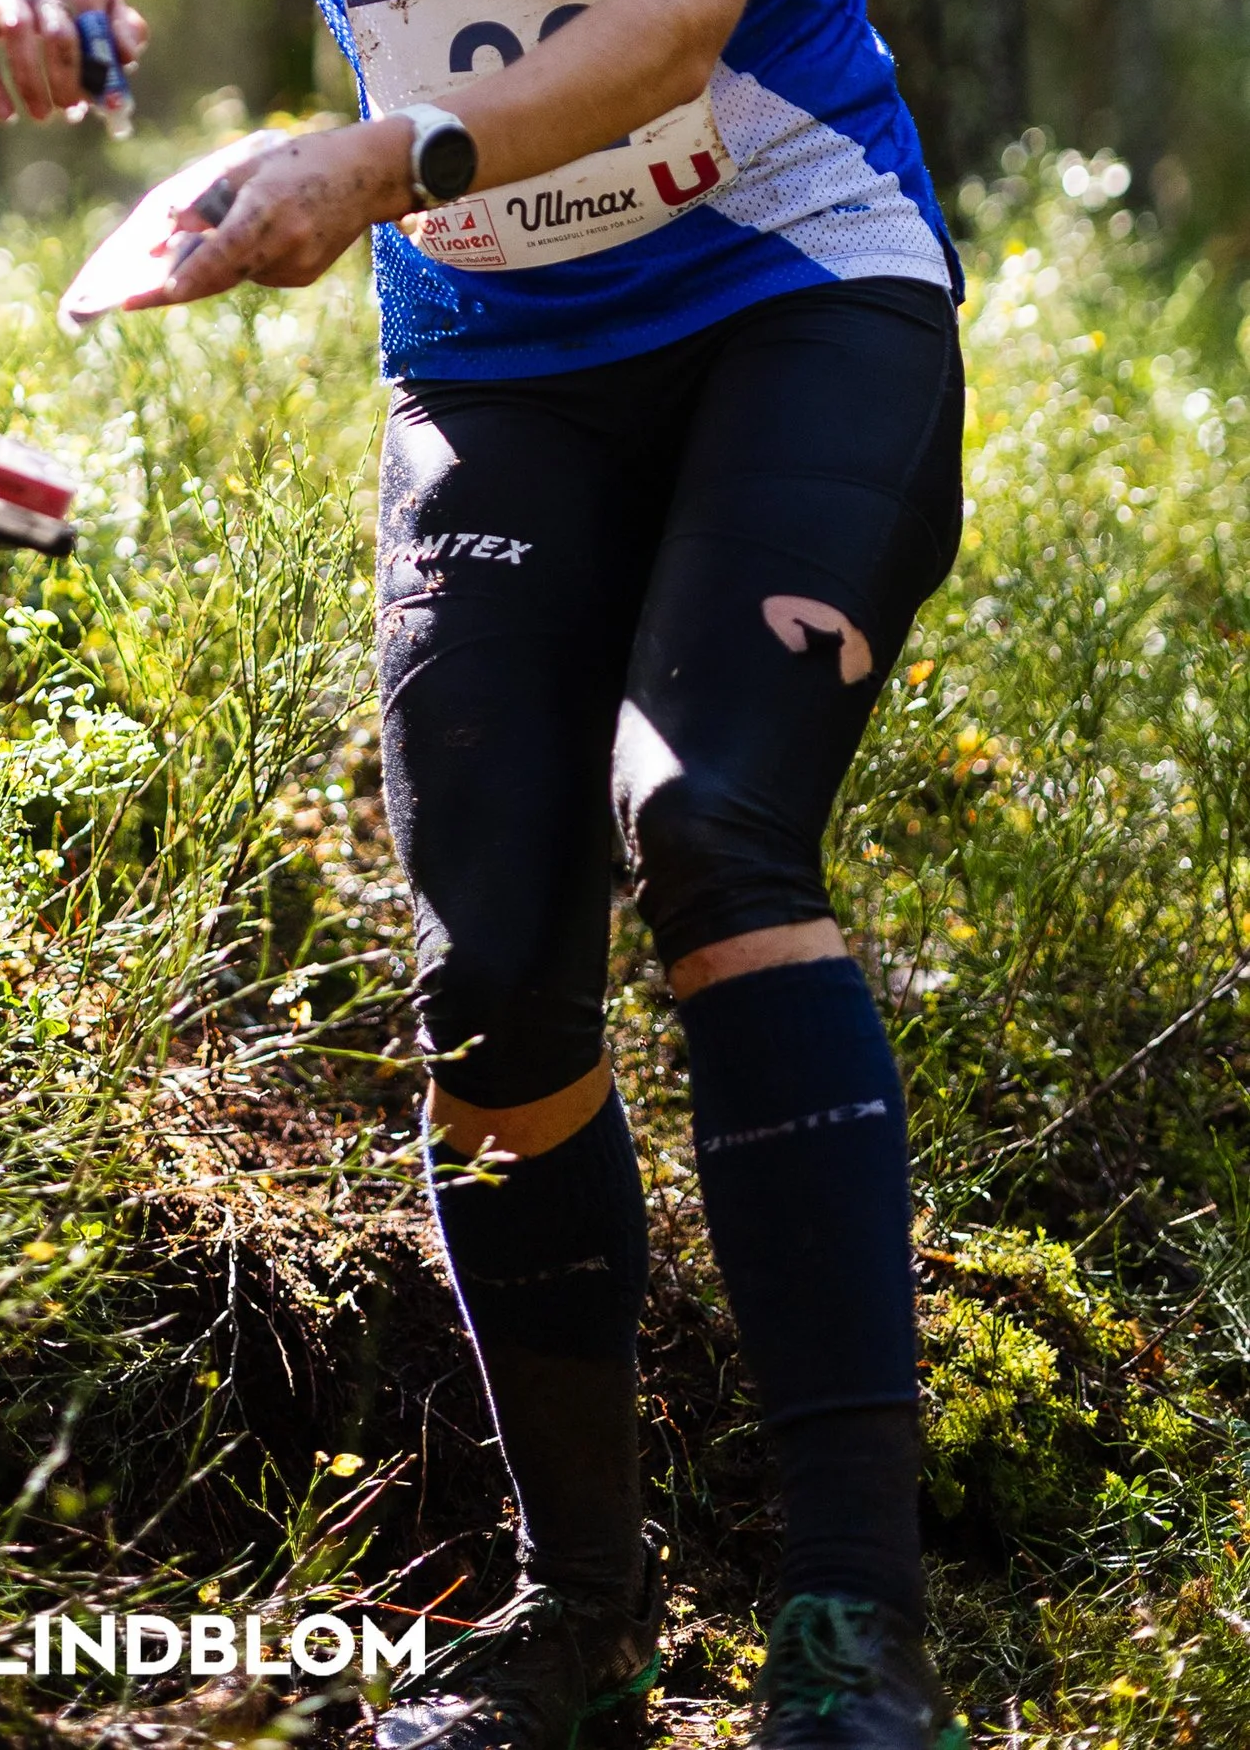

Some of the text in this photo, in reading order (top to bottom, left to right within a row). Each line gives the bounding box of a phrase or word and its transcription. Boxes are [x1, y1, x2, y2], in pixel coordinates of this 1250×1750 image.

[506, 187, 638, 232] Ullmax
[626, 215, 645, 226] ALLA
[426, 233, 495, 252] Tisaren
